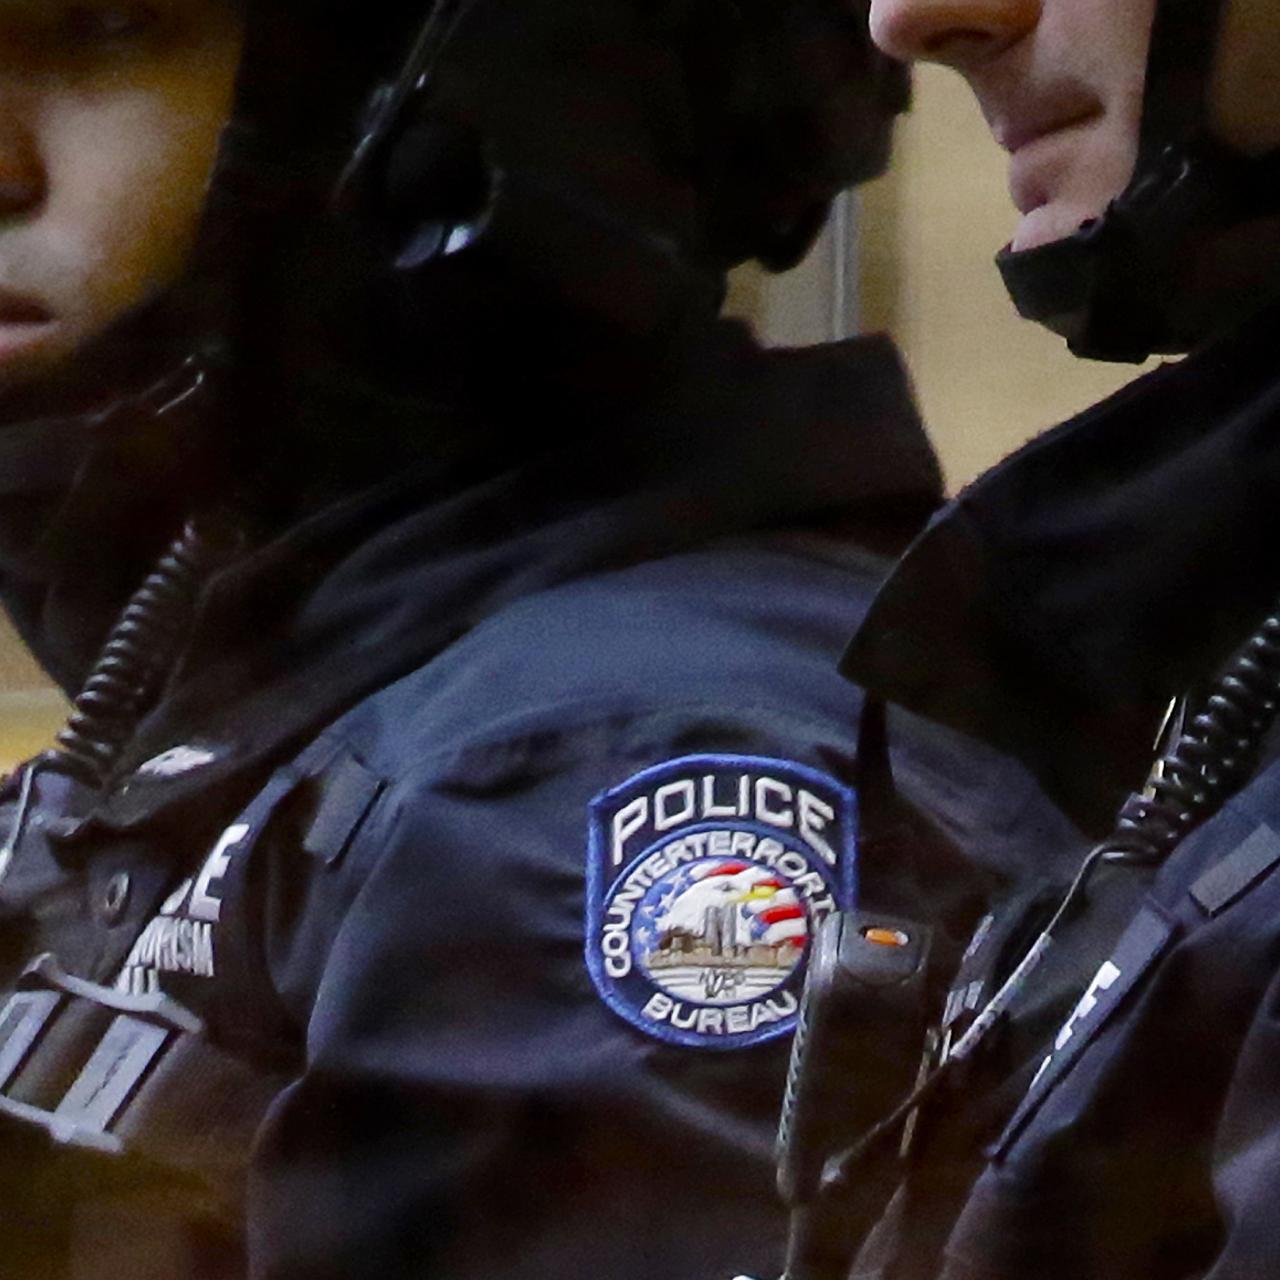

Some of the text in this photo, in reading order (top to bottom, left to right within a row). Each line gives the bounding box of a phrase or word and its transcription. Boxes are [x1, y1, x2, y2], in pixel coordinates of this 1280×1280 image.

[613, 774, 837, 866] POLICE
[601, 830, 837, 979] COUNTERTERRORI
[641, 989, 799, 1035] BUREAU
